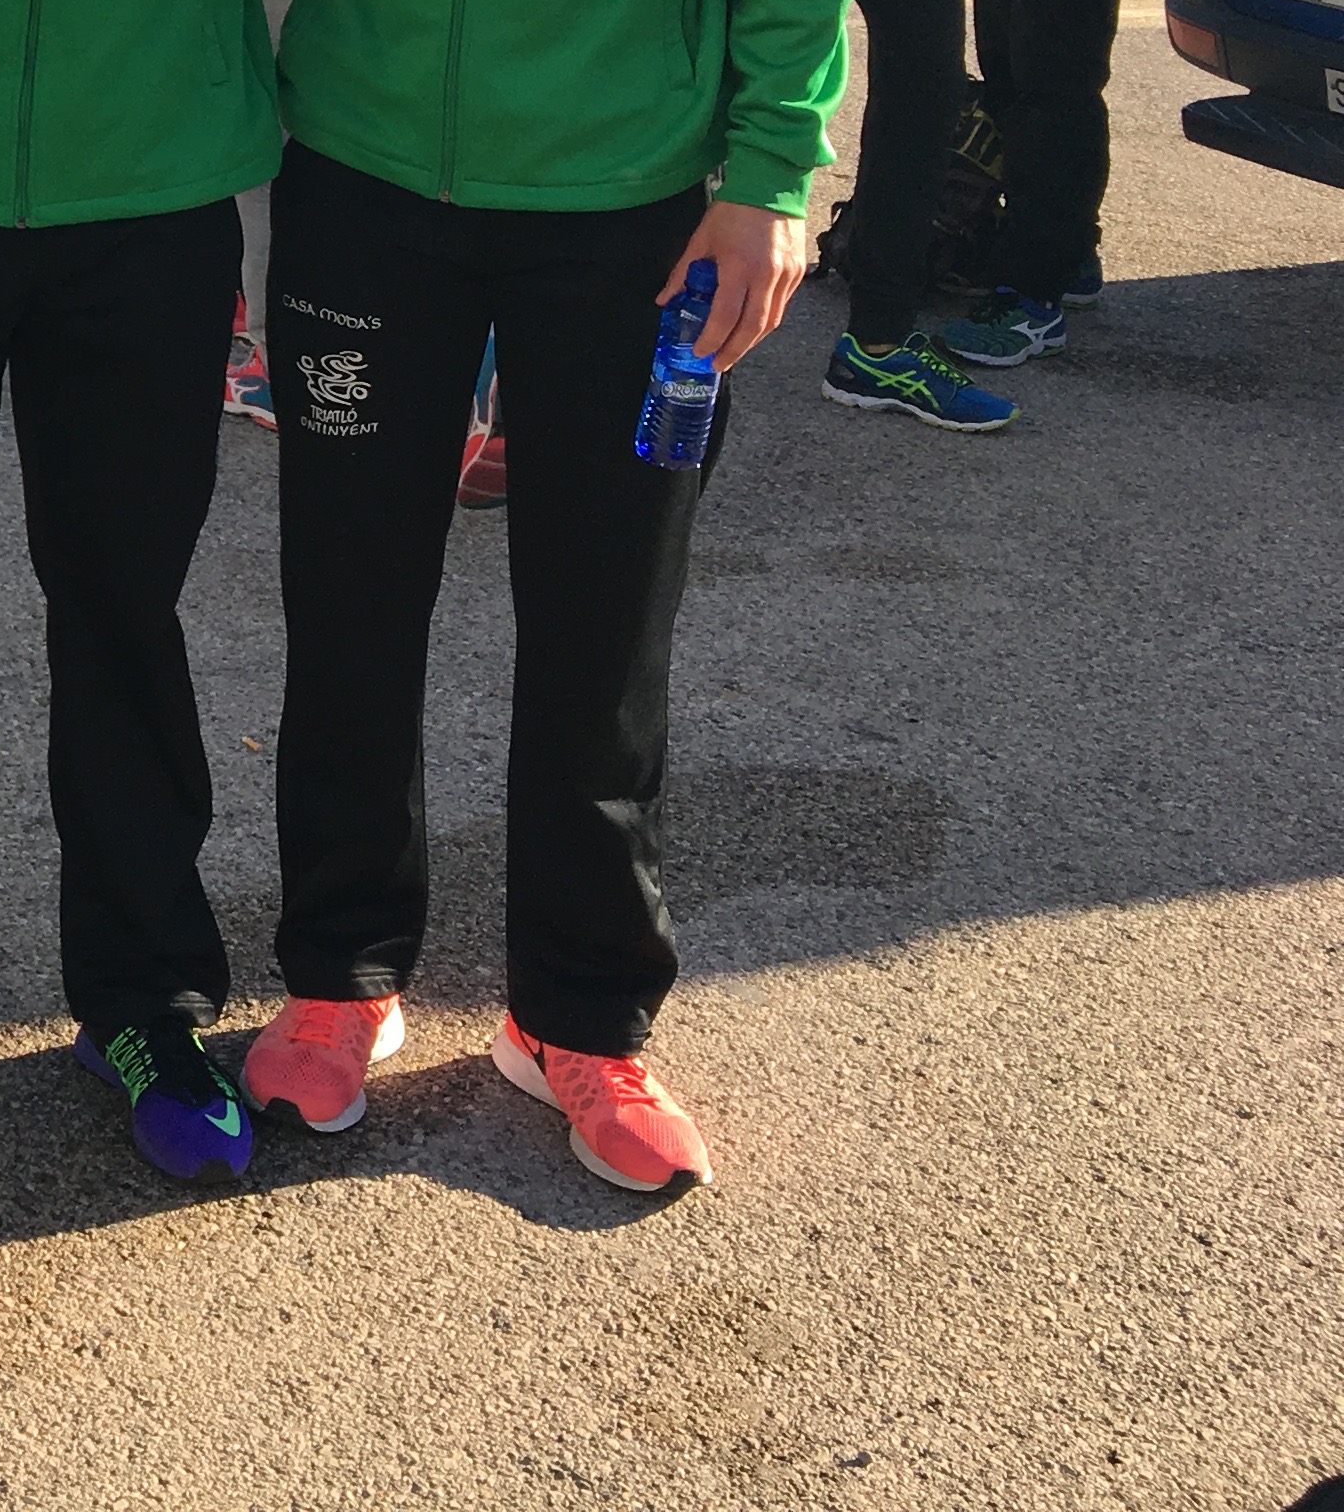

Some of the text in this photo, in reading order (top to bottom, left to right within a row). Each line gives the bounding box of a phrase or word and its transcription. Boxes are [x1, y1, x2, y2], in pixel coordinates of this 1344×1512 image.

[282, 293, 382, 330] CASA MODA'S
[310, 404, 358, 424] TRIATLÓ
[300, 416, 380, 437] ONTINYENT
